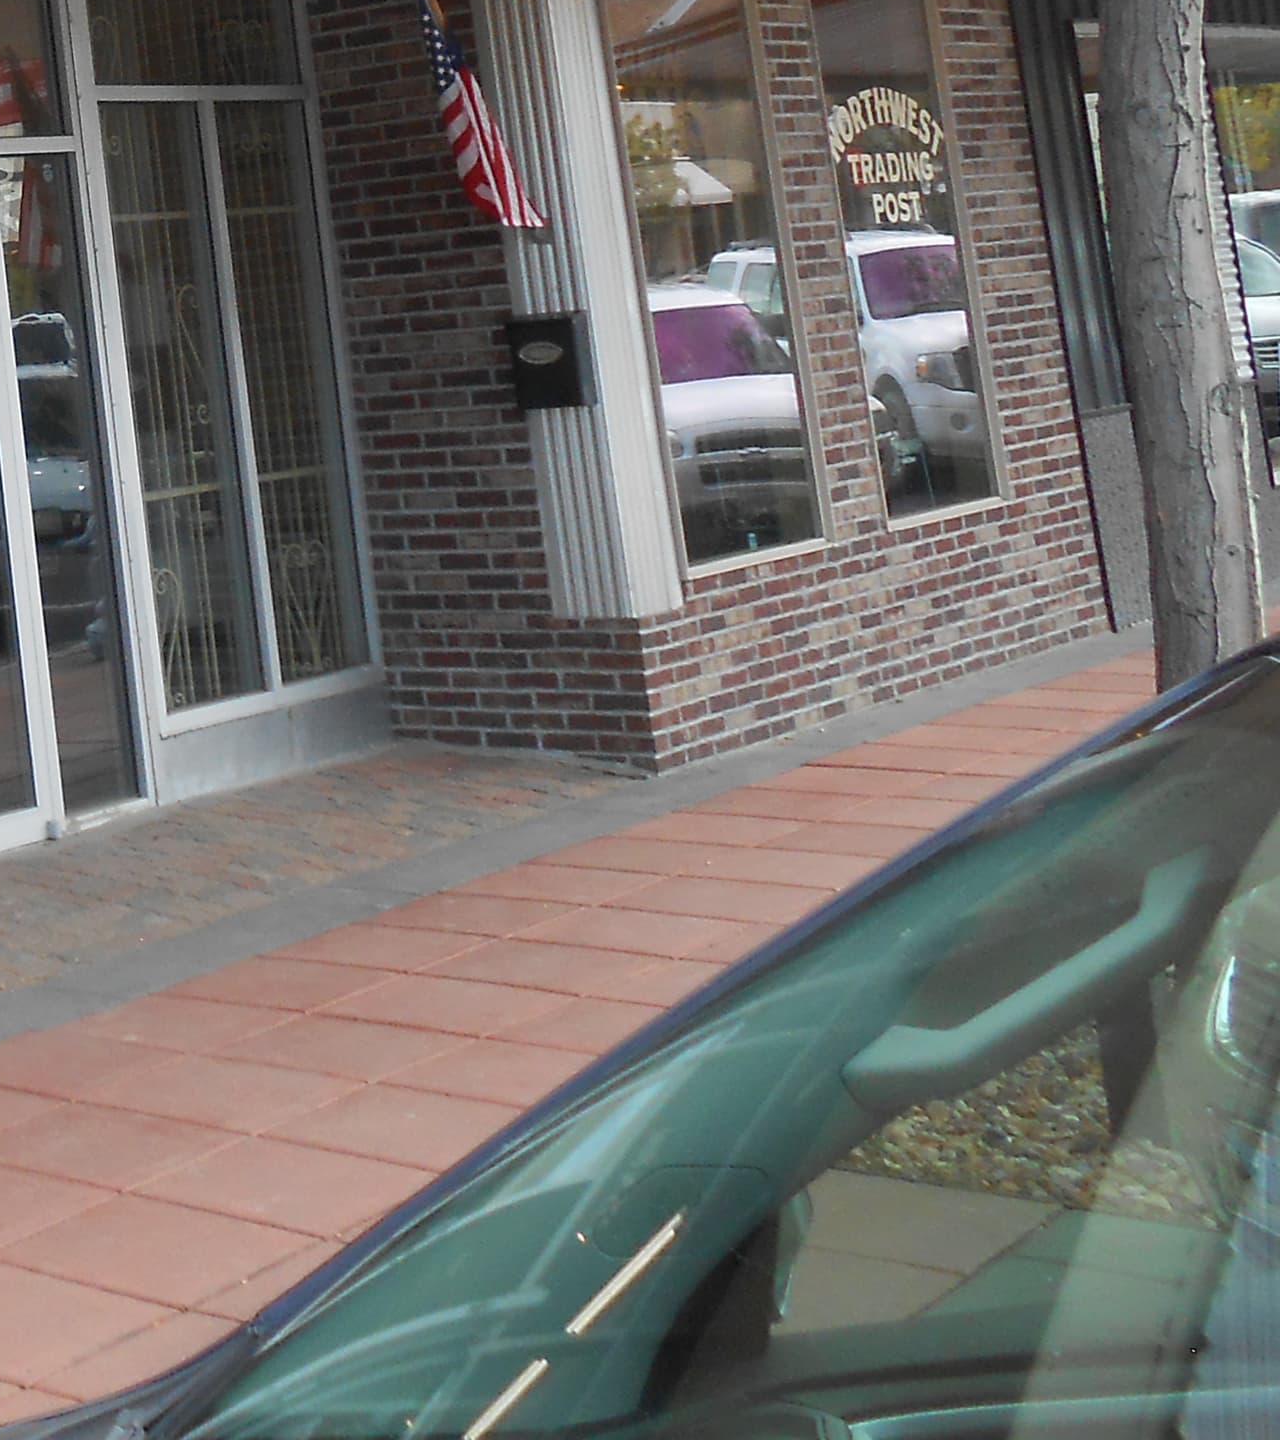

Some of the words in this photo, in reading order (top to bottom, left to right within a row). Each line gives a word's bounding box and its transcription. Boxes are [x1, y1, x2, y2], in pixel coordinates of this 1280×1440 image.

[827, 86, 944, 164] NORTHWEST
[847, 151, 934, 184] TRADING
[872, 191, 920, 224] POST
